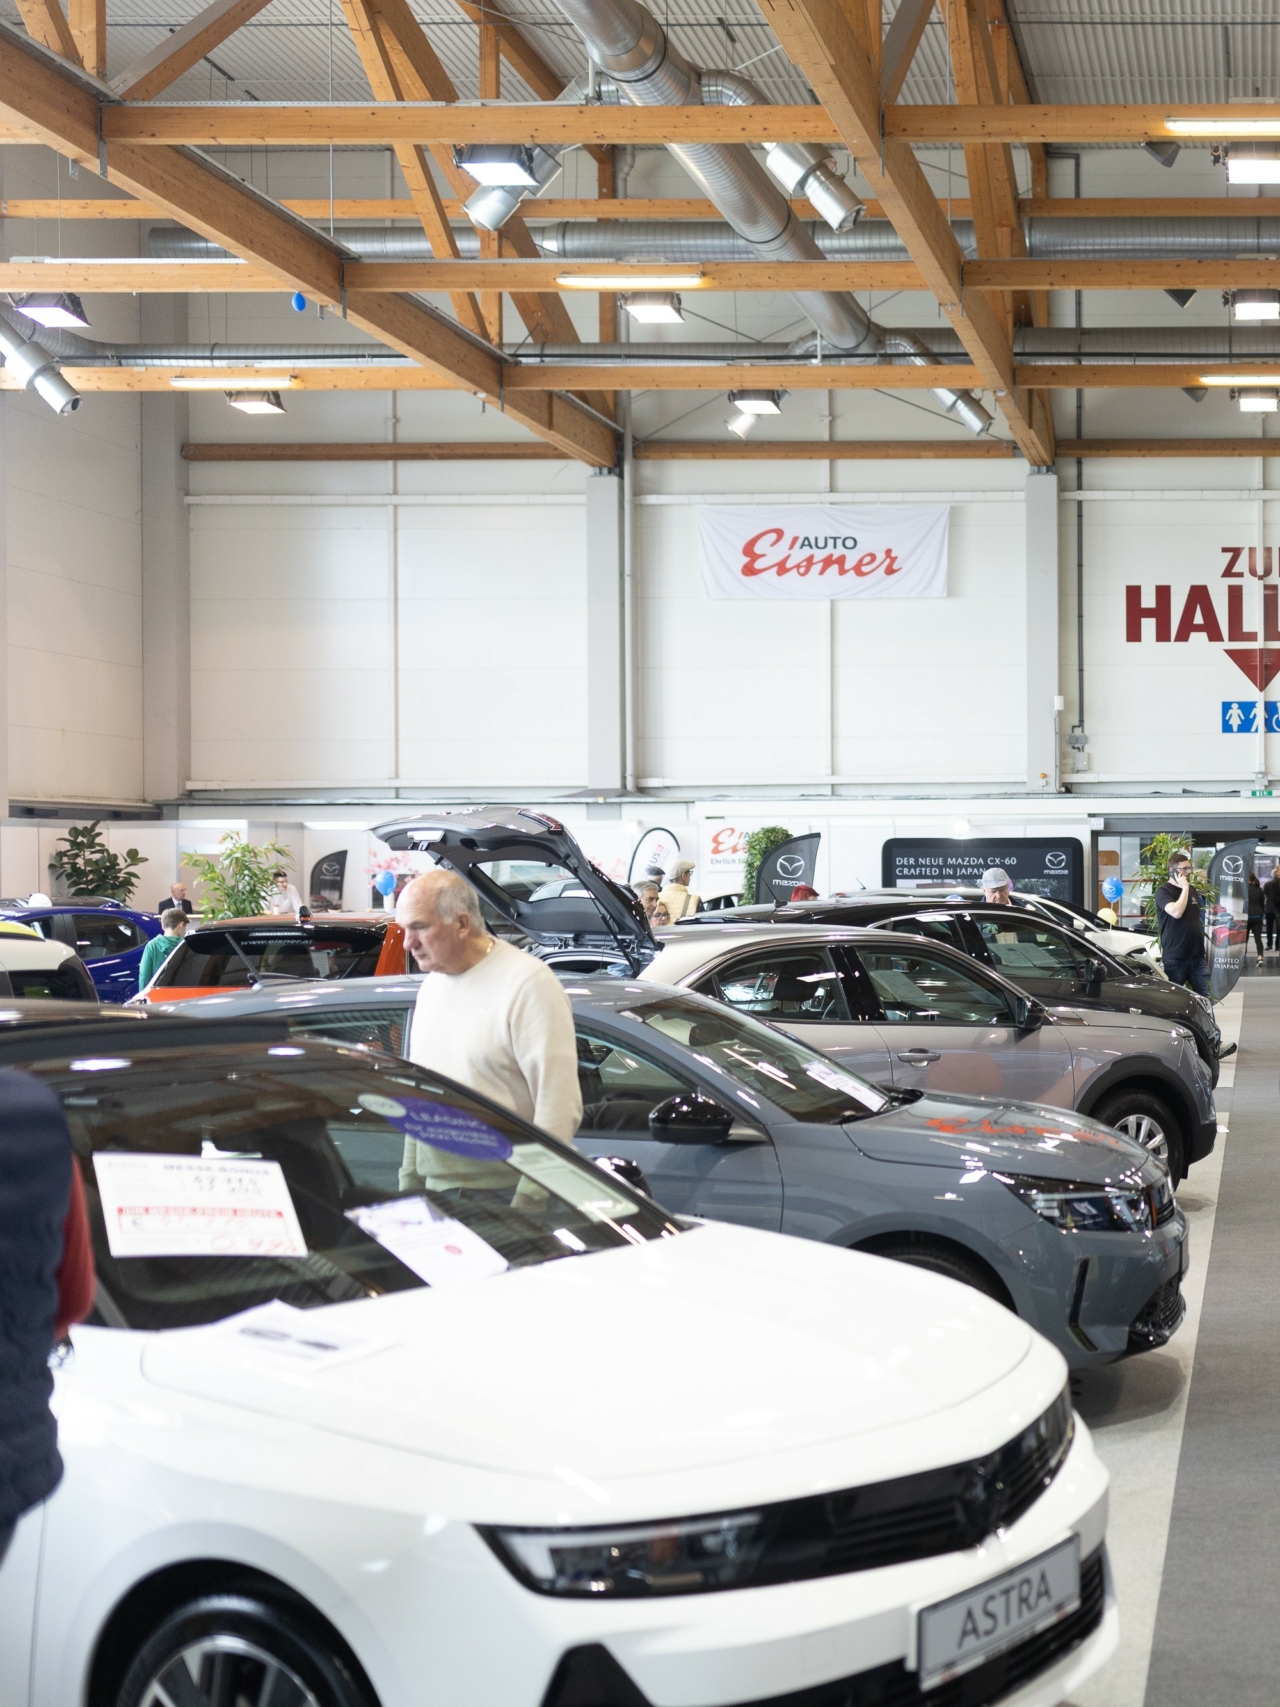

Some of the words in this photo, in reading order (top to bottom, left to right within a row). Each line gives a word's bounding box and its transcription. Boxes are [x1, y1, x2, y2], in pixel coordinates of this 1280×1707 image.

[799, 536, 858, 551] AUTO
[740, 527, 903, 578] Eisner
[710, 858, 737, 866] Ehrlich
[896, 857, 915, 866] DER
[918, 857, 944, 866] NEUE
[947, 857, 985, 866] MAZDA
[987, 857, 1017, 866] CX-60
[896, 867, 940, 876] CRAFTED
[943, 867, 953, 876] IN
[956, 867, 986, 877] JAPAN
[957, 1569, 1052, 1649] ASTRA
